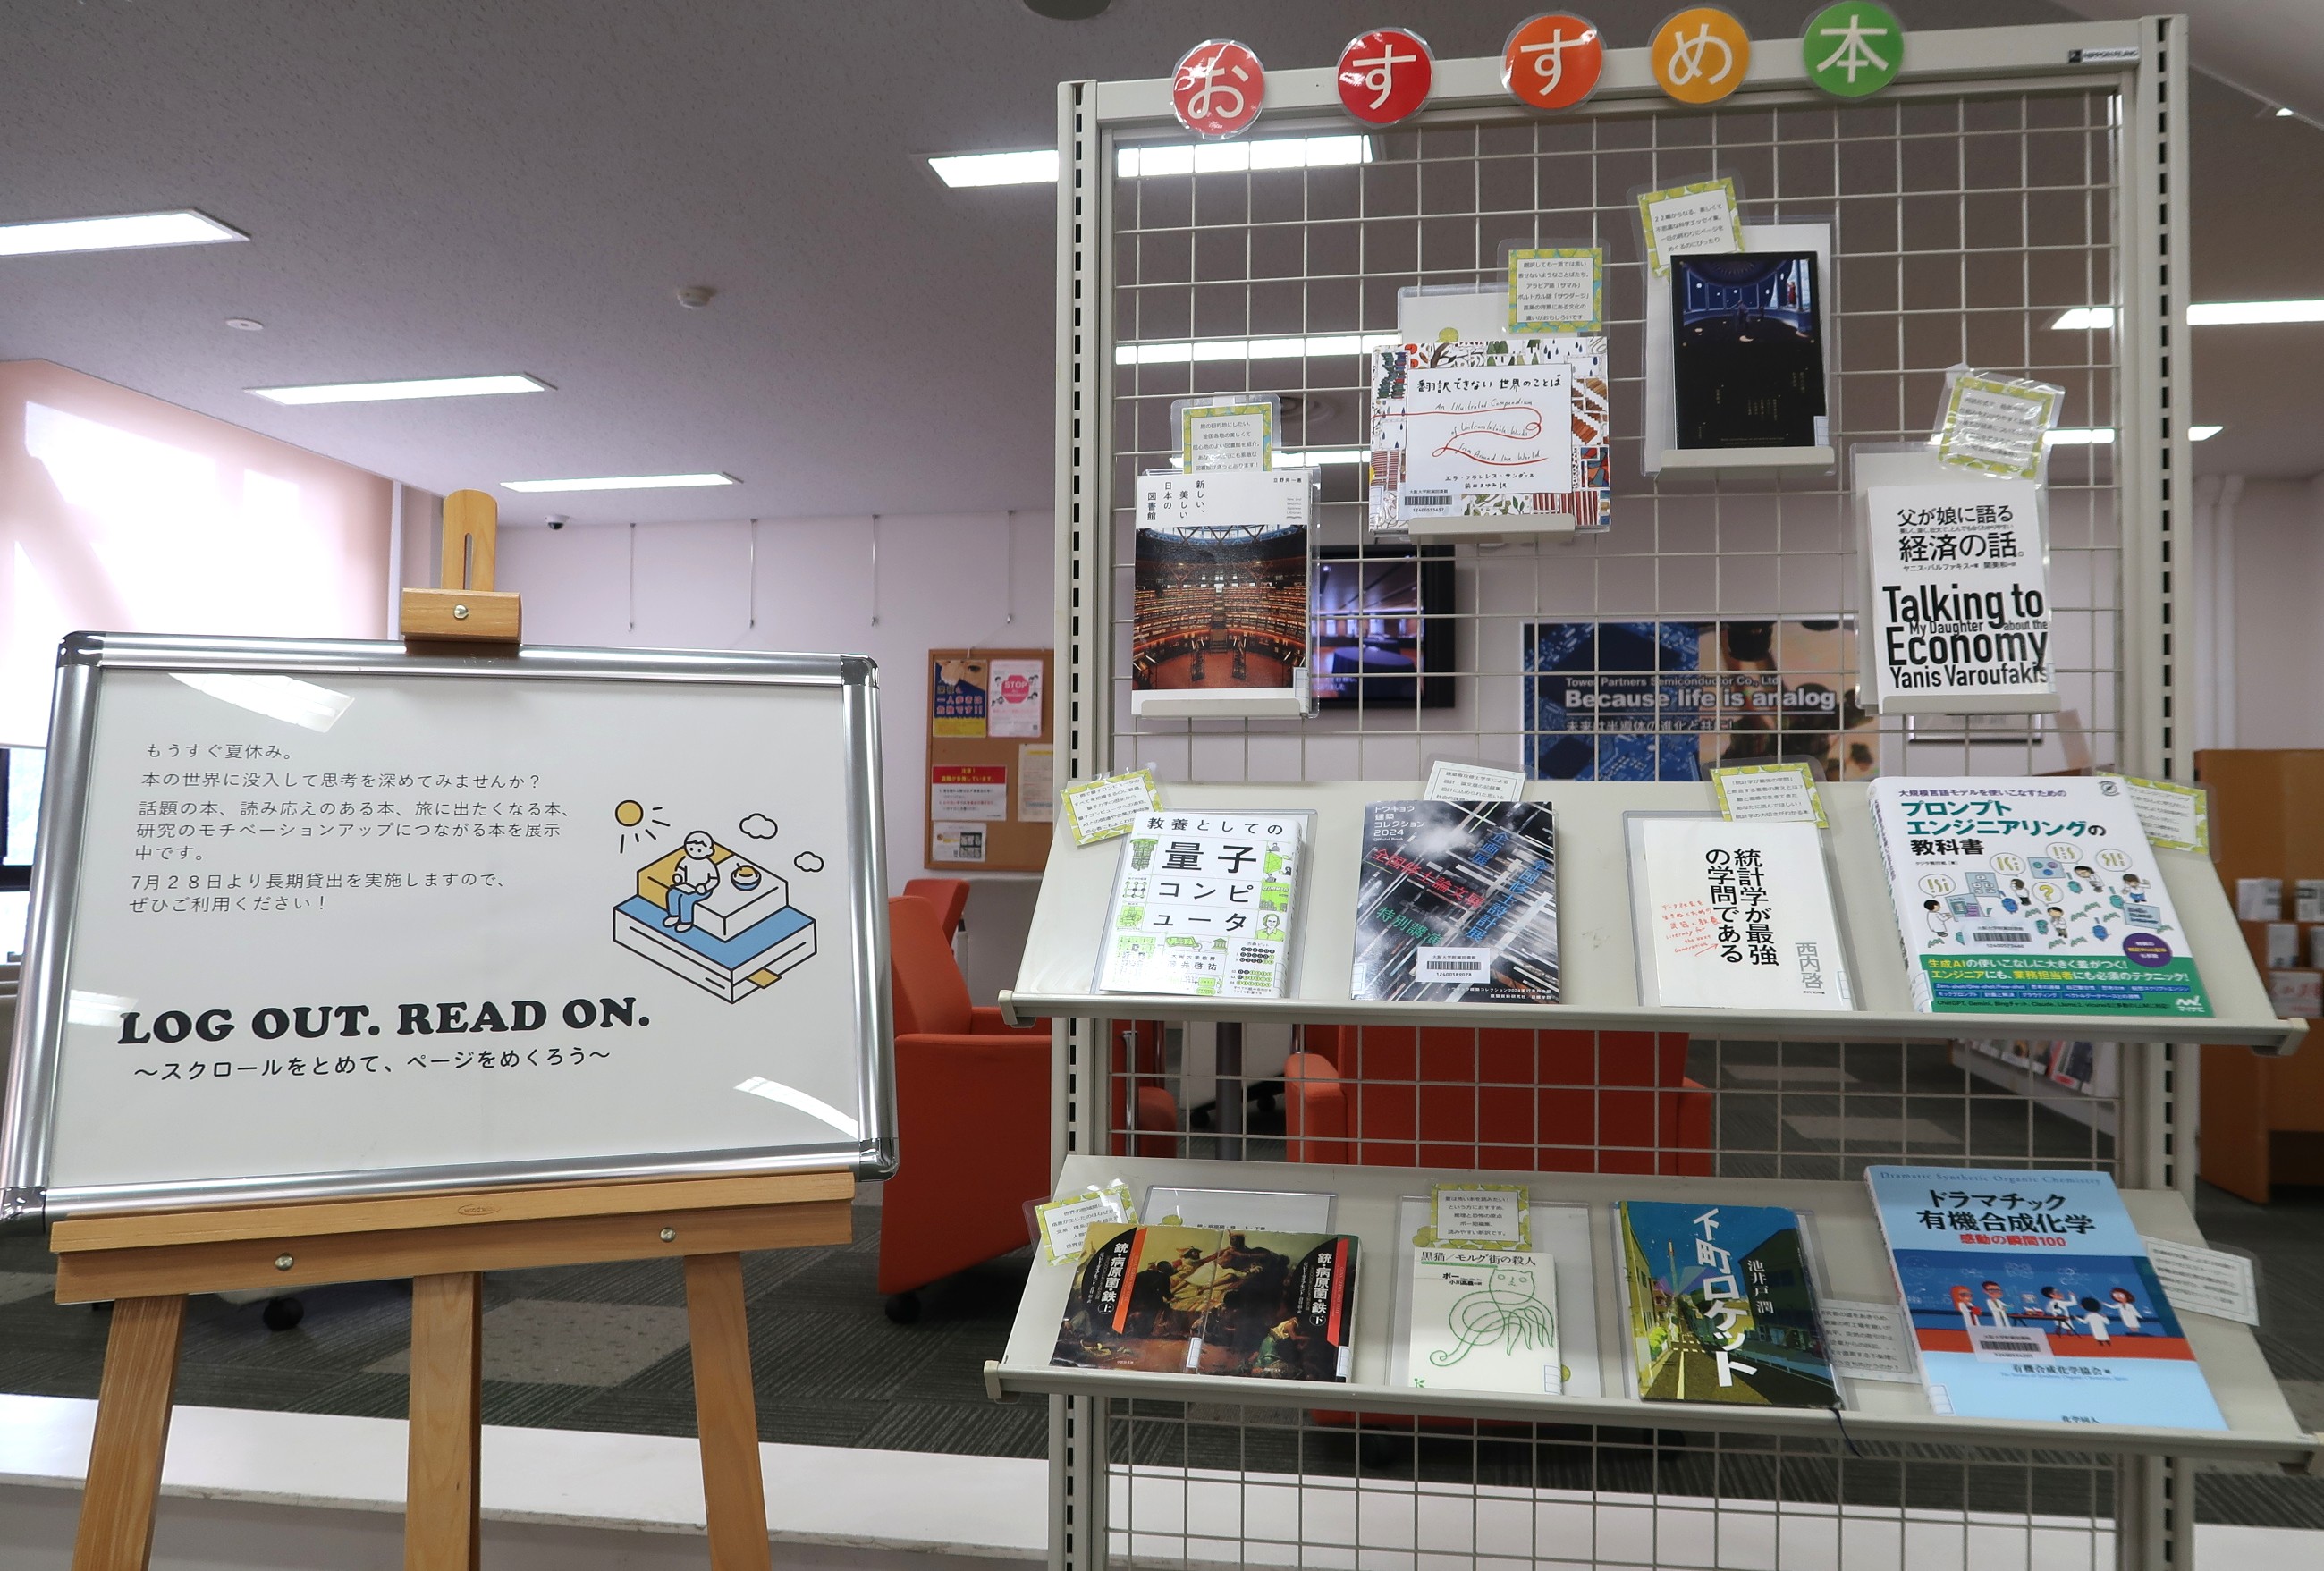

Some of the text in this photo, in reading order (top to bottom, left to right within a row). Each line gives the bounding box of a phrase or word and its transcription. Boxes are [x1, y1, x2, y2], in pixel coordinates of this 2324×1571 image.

[1187, 14, 1888, 119] おすすめ本
[1417, 374, 1561, 394] 翻訳できない 世界のことば
[1147, 492, 1156, 520] 図書館
[1163, 482, 1172, 510] 日本の
[1179, 490, 1188, 519] 美しい
[1196, 480, 1204, 513] 新しい、
[1897, 505, 2014, 527] 父が娘に語る
[1898, 531, 2024, 562] 経済の話。
[1882, 584, 2043, 628] Talking to
[1910, 620, 2048, 638] My Daughter about the
[1887, 626, 2049, 670] Economy
[1601, 677, 1647, 687] Partners
[1890, 661, 2049, 688] Yanis Varoufakis
[1565, 688, 1837, 711] Because life is analog
[147, 743, 292, 760] もうすぐ夏休み。
[141, 772, 540, 789] 本の世界に没入して思考を深めてみませんか？
[139, 801, 570, 816] 話題の本、読み応えのある本、旅に出たくなる本、
[1901, 800, 2012, 817] プロンプト
[136, 822, 562, 839] 研究のモチベーションアップにつながる本を展示
[1147, 816, 1283, 835] 教養としての
[1907, 819, 2107, 837] エンジニアリングの
[135, 845, 203, 861] 中です。
[1162, 841, 1256, 874] 量子
[1910, 839, 1985, 856] 教科書
[129, 895, 325, 913] ぜひご利用ください！
[1159, 883, 1254, 903] コンピ
[1705, 849, 1744, 963] の学問である
[1734, 849, 1779, 967] 統計学が最強
[1153, 913, 1247, 932] ユータ
[1796, 942, 1824, 989] 西内啓
[117, 997, 649, 1043] LOG OUT. READ ON.
[1880, 1172, 2101, 1187] Dramatic Synthetic Organic Chemistry
[1929, 1189, 2066, 1212] ドラマチック
[1916, 1210, 2096, 1235] 有機合成化学
[1959, 1233, 2067, 1246] 感動の瞬間100
[1421, 1252, 1536, 1266] 黒猫／モルグ街の殺人
[1101, 1243, 1128, 1302] 銃・病原菌・鉄
[1311, 1253, 1332, 1313] 銃・病原菌・鉄
[1694, 1208, 1758, 1388] 下町ロケット
[1746, 1259, 1774, 1314] 池井戸潤
